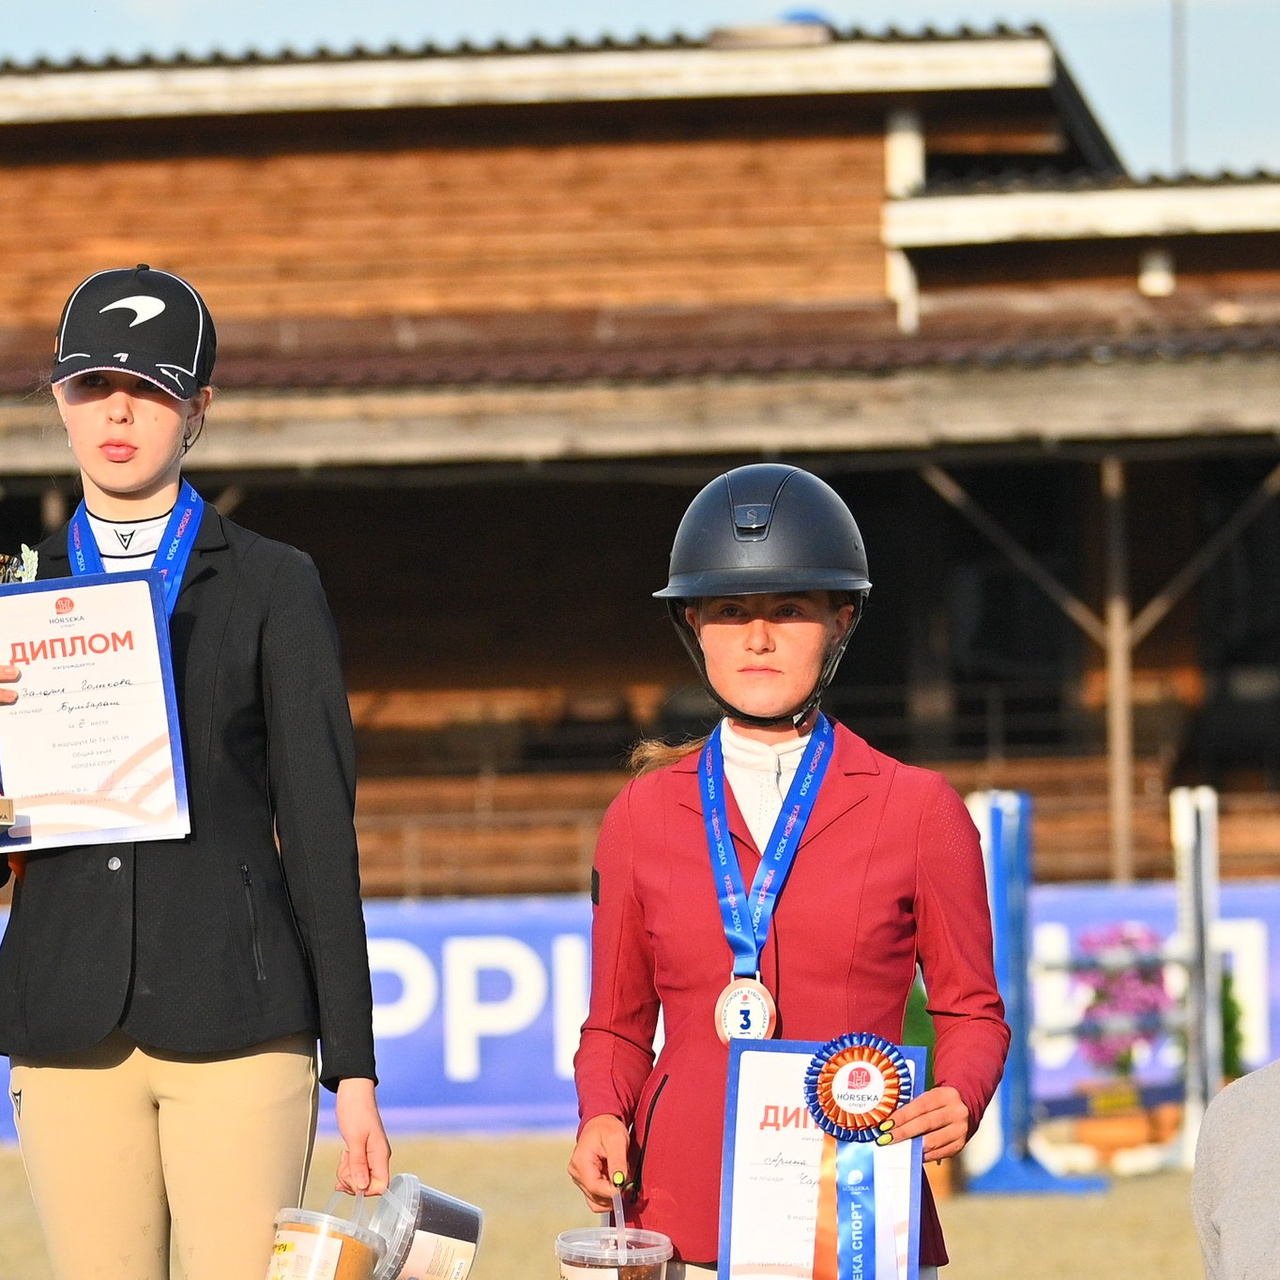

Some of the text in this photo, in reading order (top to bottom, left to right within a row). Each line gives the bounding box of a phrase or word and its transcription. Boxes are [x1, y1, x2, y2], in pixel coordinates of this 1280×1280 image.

[166, 508, 193, 560] КУБОК HORSEKA
[9, 630, 134, 667] ДИПЛОМ
[800, 741, 825, 797] КУБОК HORSEKA
[717, 842, 727, 865] КУБОК
[773, 804, 801, 861] КУБОК HORSEKA
[724, 874, 741, 932] КУБОК HORSEKA
[757, 869, 776, 905] HORSEKA
[740, 1010, 751, 1031] 3
[836, 1091, 879, 1103] HÓRSEKA
[850, 1202, 863, 1250] СПОРТ
